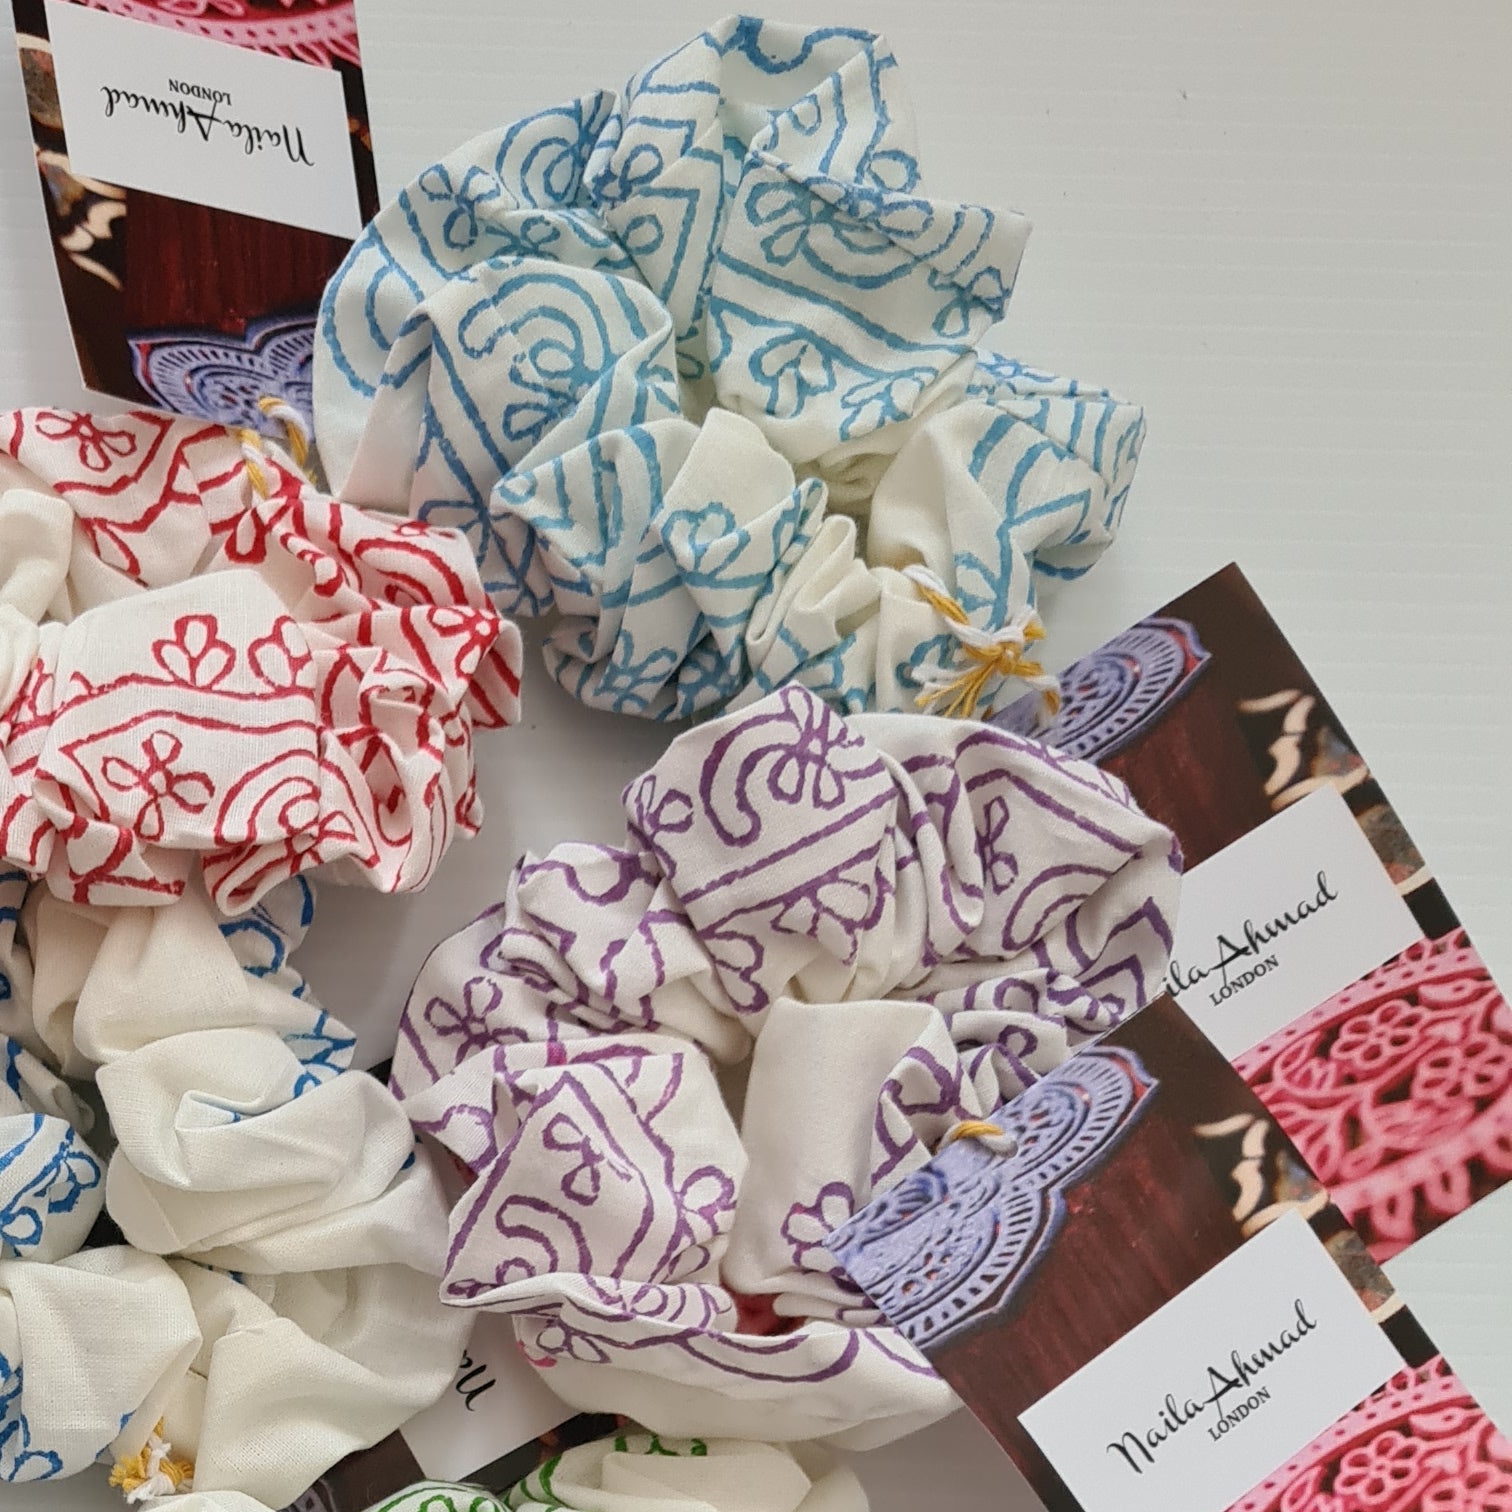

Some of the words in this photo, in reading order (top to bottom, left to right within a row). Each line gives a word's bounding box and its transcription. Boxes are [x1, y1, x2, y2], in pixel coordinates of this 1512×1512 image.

[101, 86, 223, 141] Ahmad
[169, 79, 232, 105] LONDON
[223, 120, 314, 166] Naila
[1163, 961, 1210, 998] ila
[1209, 870, 1338, 989] Ahmad
[1209, 954, 1280, 1006] LONDON
[1106, 1394, 1204, 1474] Naila
[1201, 1299, 1317, 1421] Ahmad
[1207, 1386, 1271, 1442] LONDON
